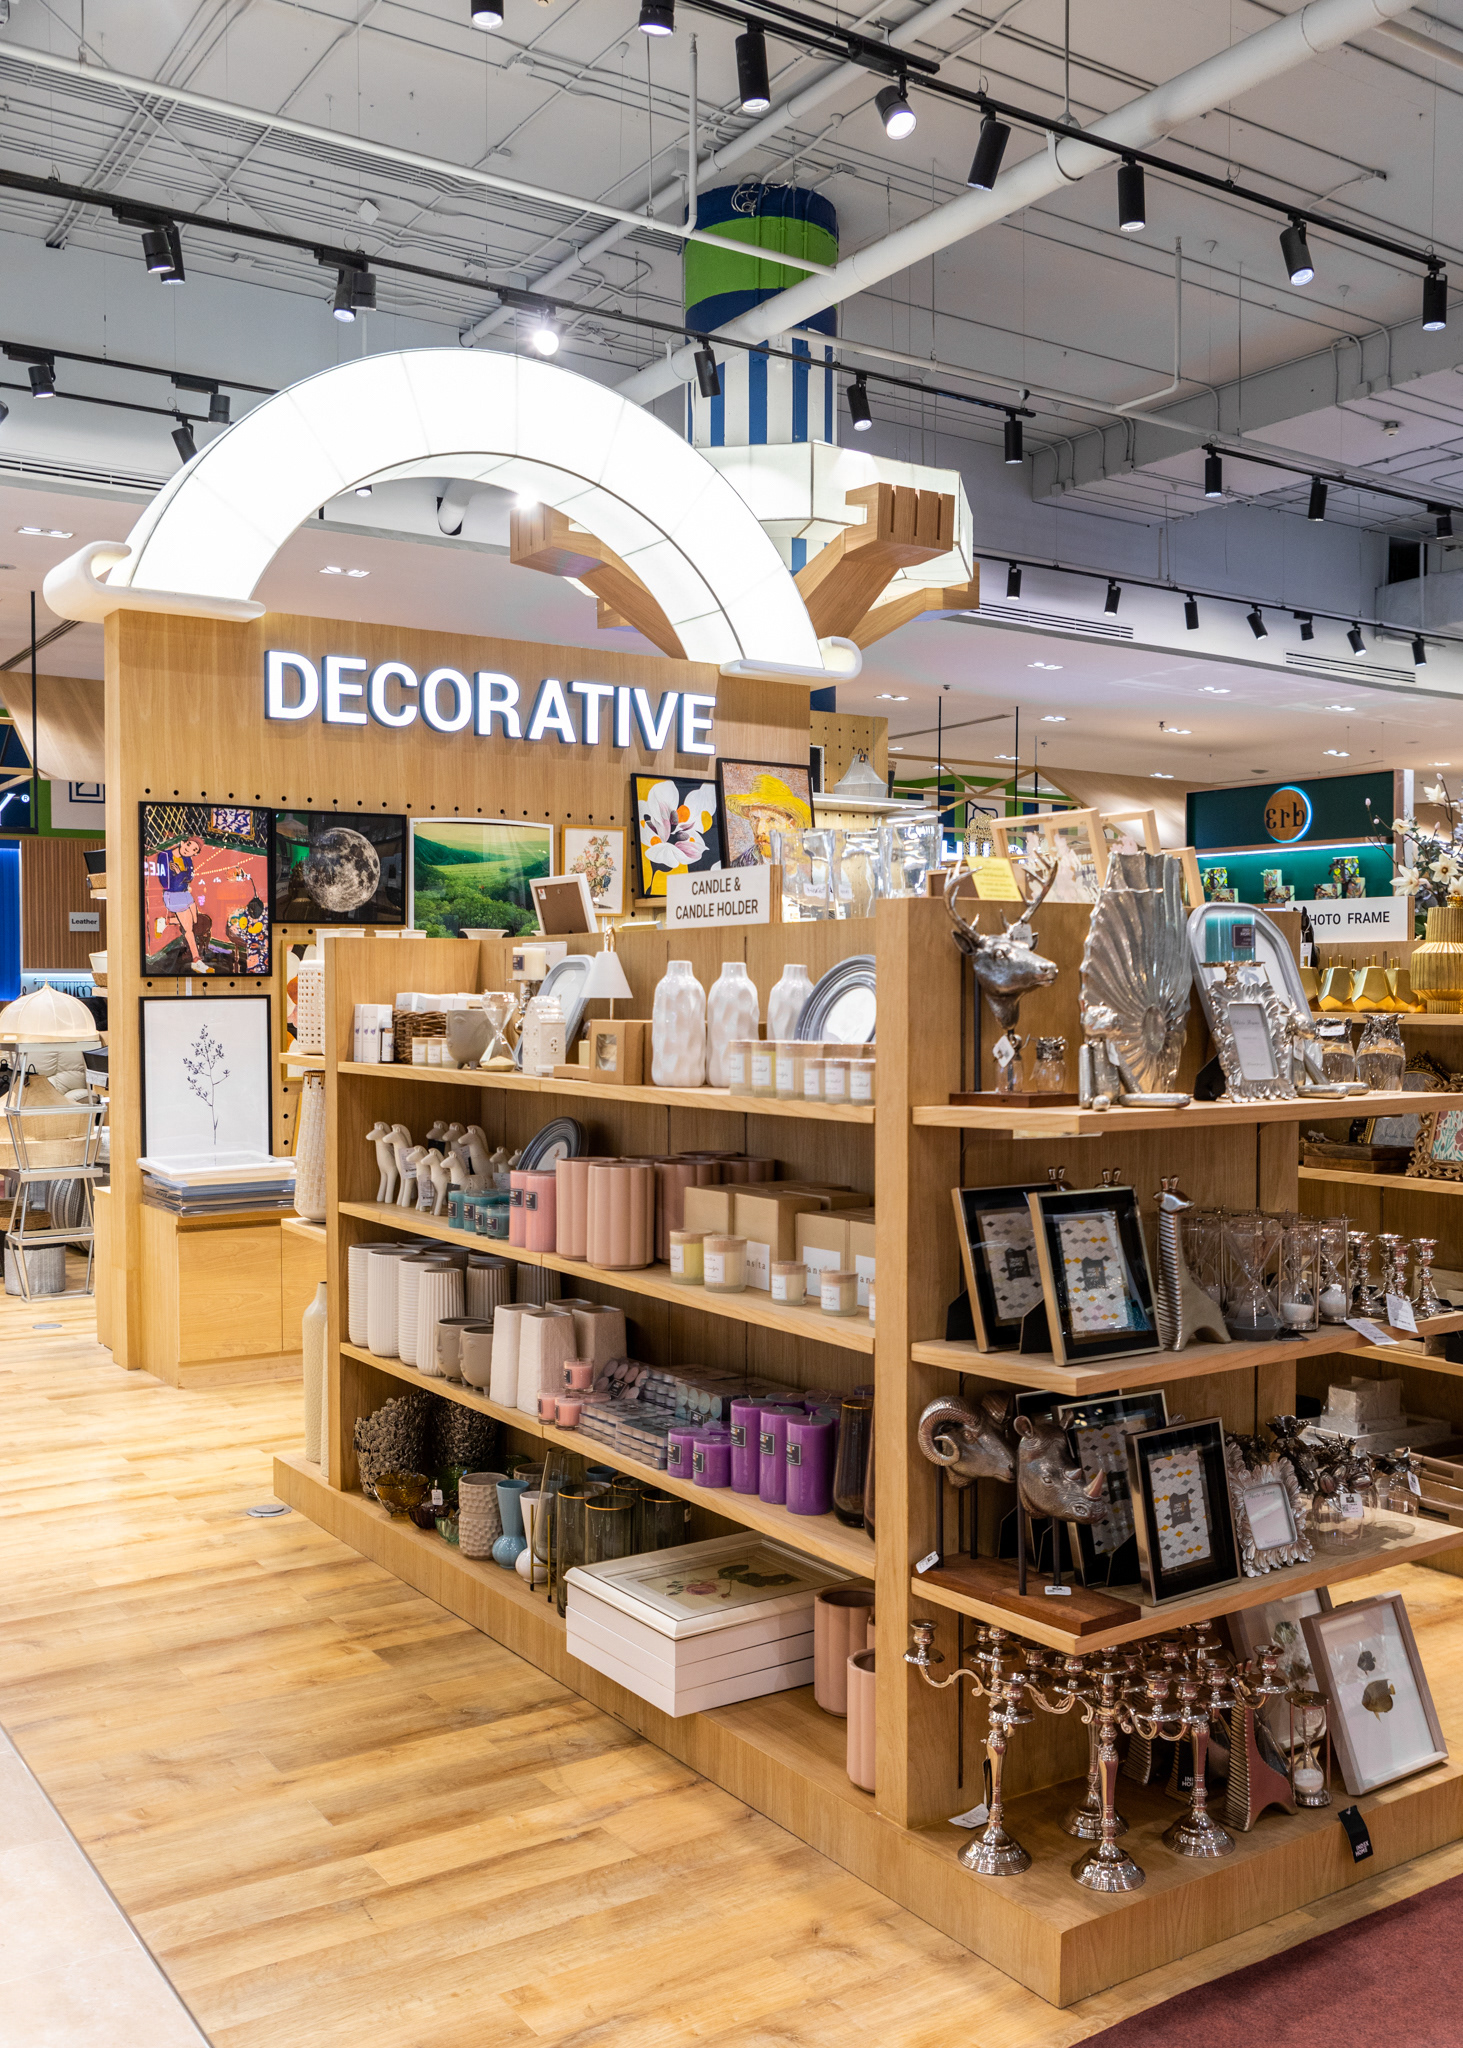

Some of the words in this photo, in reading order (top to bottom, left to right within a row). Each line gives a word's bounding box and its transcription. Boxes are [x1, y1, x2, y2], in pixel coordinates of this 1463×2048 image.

[264, 649, 716, 755] DECORATIVE
[691, 877, 731, 895] CANDLE
[734, 876, 741, 891] &
[675, 902, 714, 920] CANDLE
[717, 899, 759, 916] HOLDER
[1309, 913, 1341, 926] HOTO
[1347, 911, 1390, 925] FRAME
